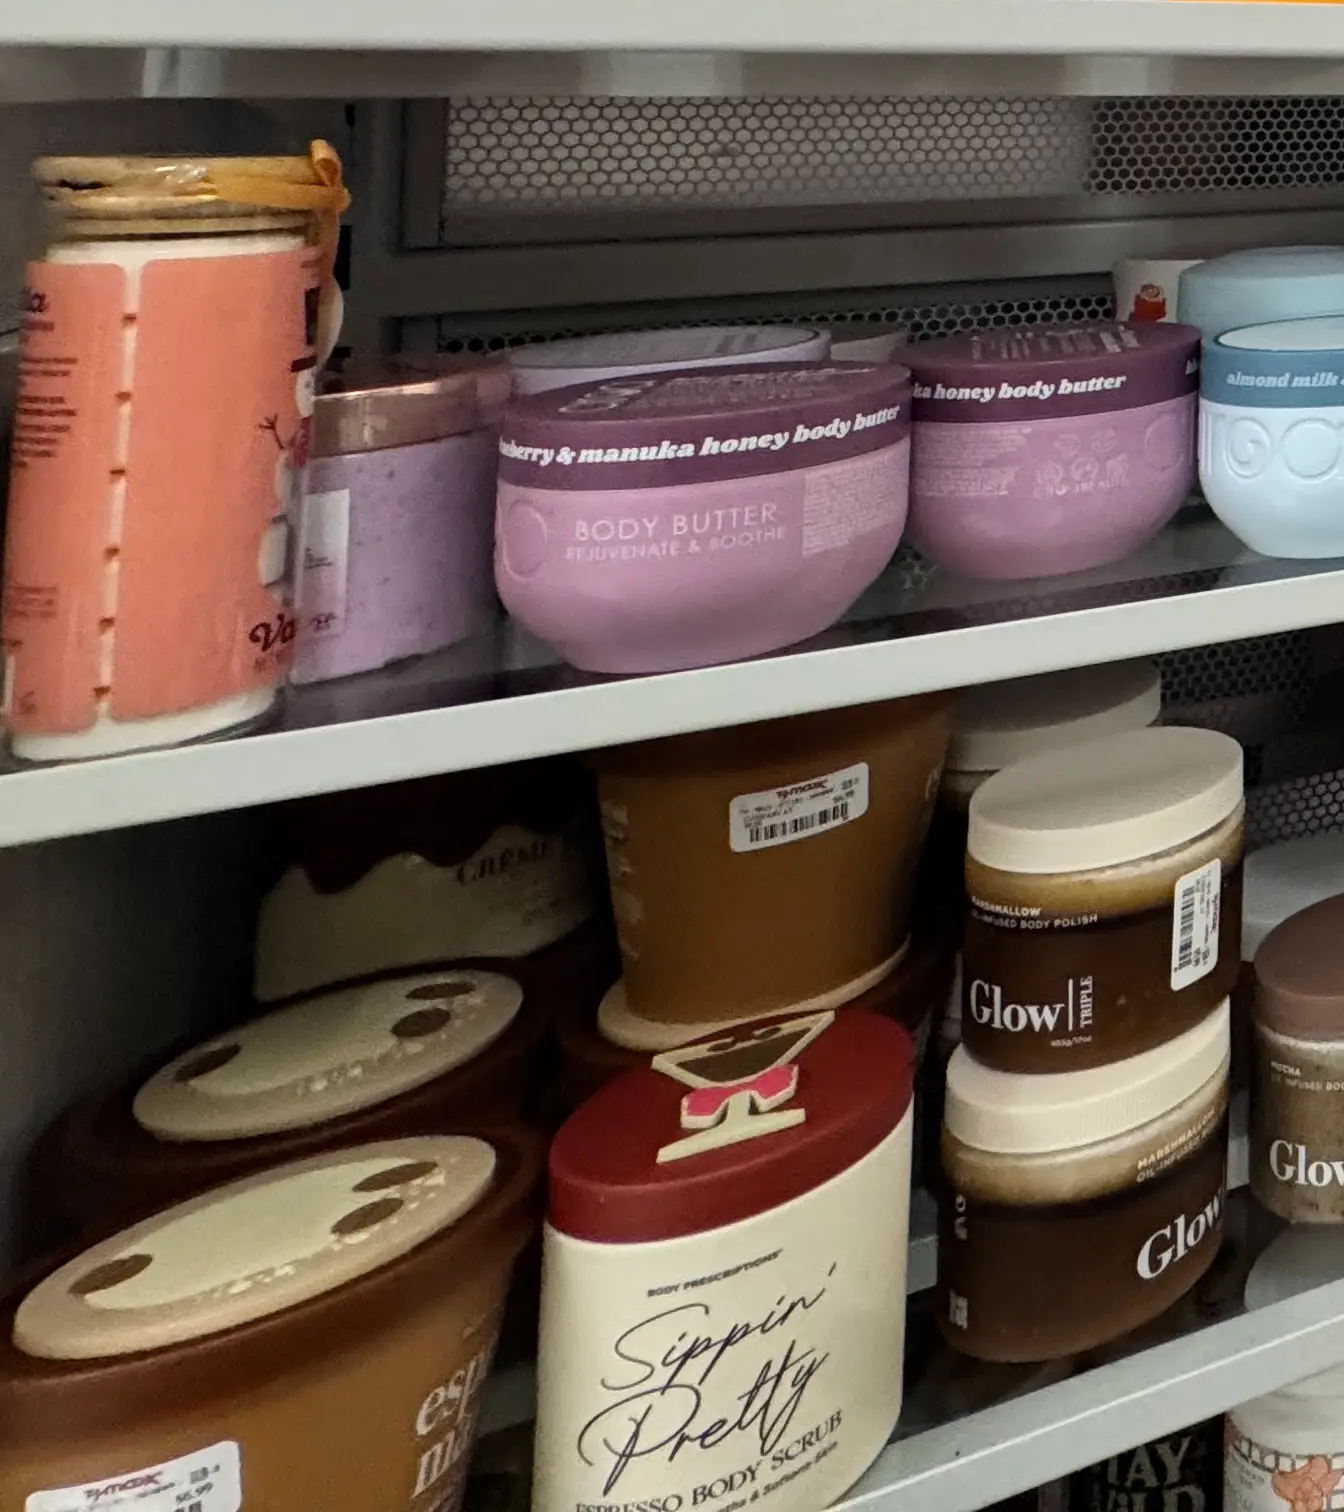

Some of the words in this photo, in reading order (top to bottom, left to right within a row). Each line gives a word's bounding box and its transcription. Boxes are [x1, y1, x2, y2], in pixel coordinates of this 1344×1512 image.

[934, 380, 997, 404] honey
[997, 377, 1055, 401] body
[1056, 372, 1127, 397] butter
[1225, 369, 1291, 389] almond
[1291, 365, 1340, 389] milk
[555, 445, 576, 467] &
[576, 438, 698, 466] manuka
[698, 429, 791, 460] honey
[793, 416, 852, 445] body
[852, 403, 902, 436] butter
[571, 512, 661, 543] BODY
[671, 500, 780, 538] BUTTER
[1019, 914, 1051, 930] BODY
[1053, 912, 1099, 929] POLISH
[969, 976, 1066, 1033] Glow
[1079, 974, 1094, 1029] TRIPLE
[1135, 1188, 1224, 1282] Glow
[600, 1260, 837, 1393] Sippin'
[577, 1339, 831, 1497] Pretty
[691, 1458, 762, 1506] BODY
[770, 1409, 843, 1470] SCRUB
